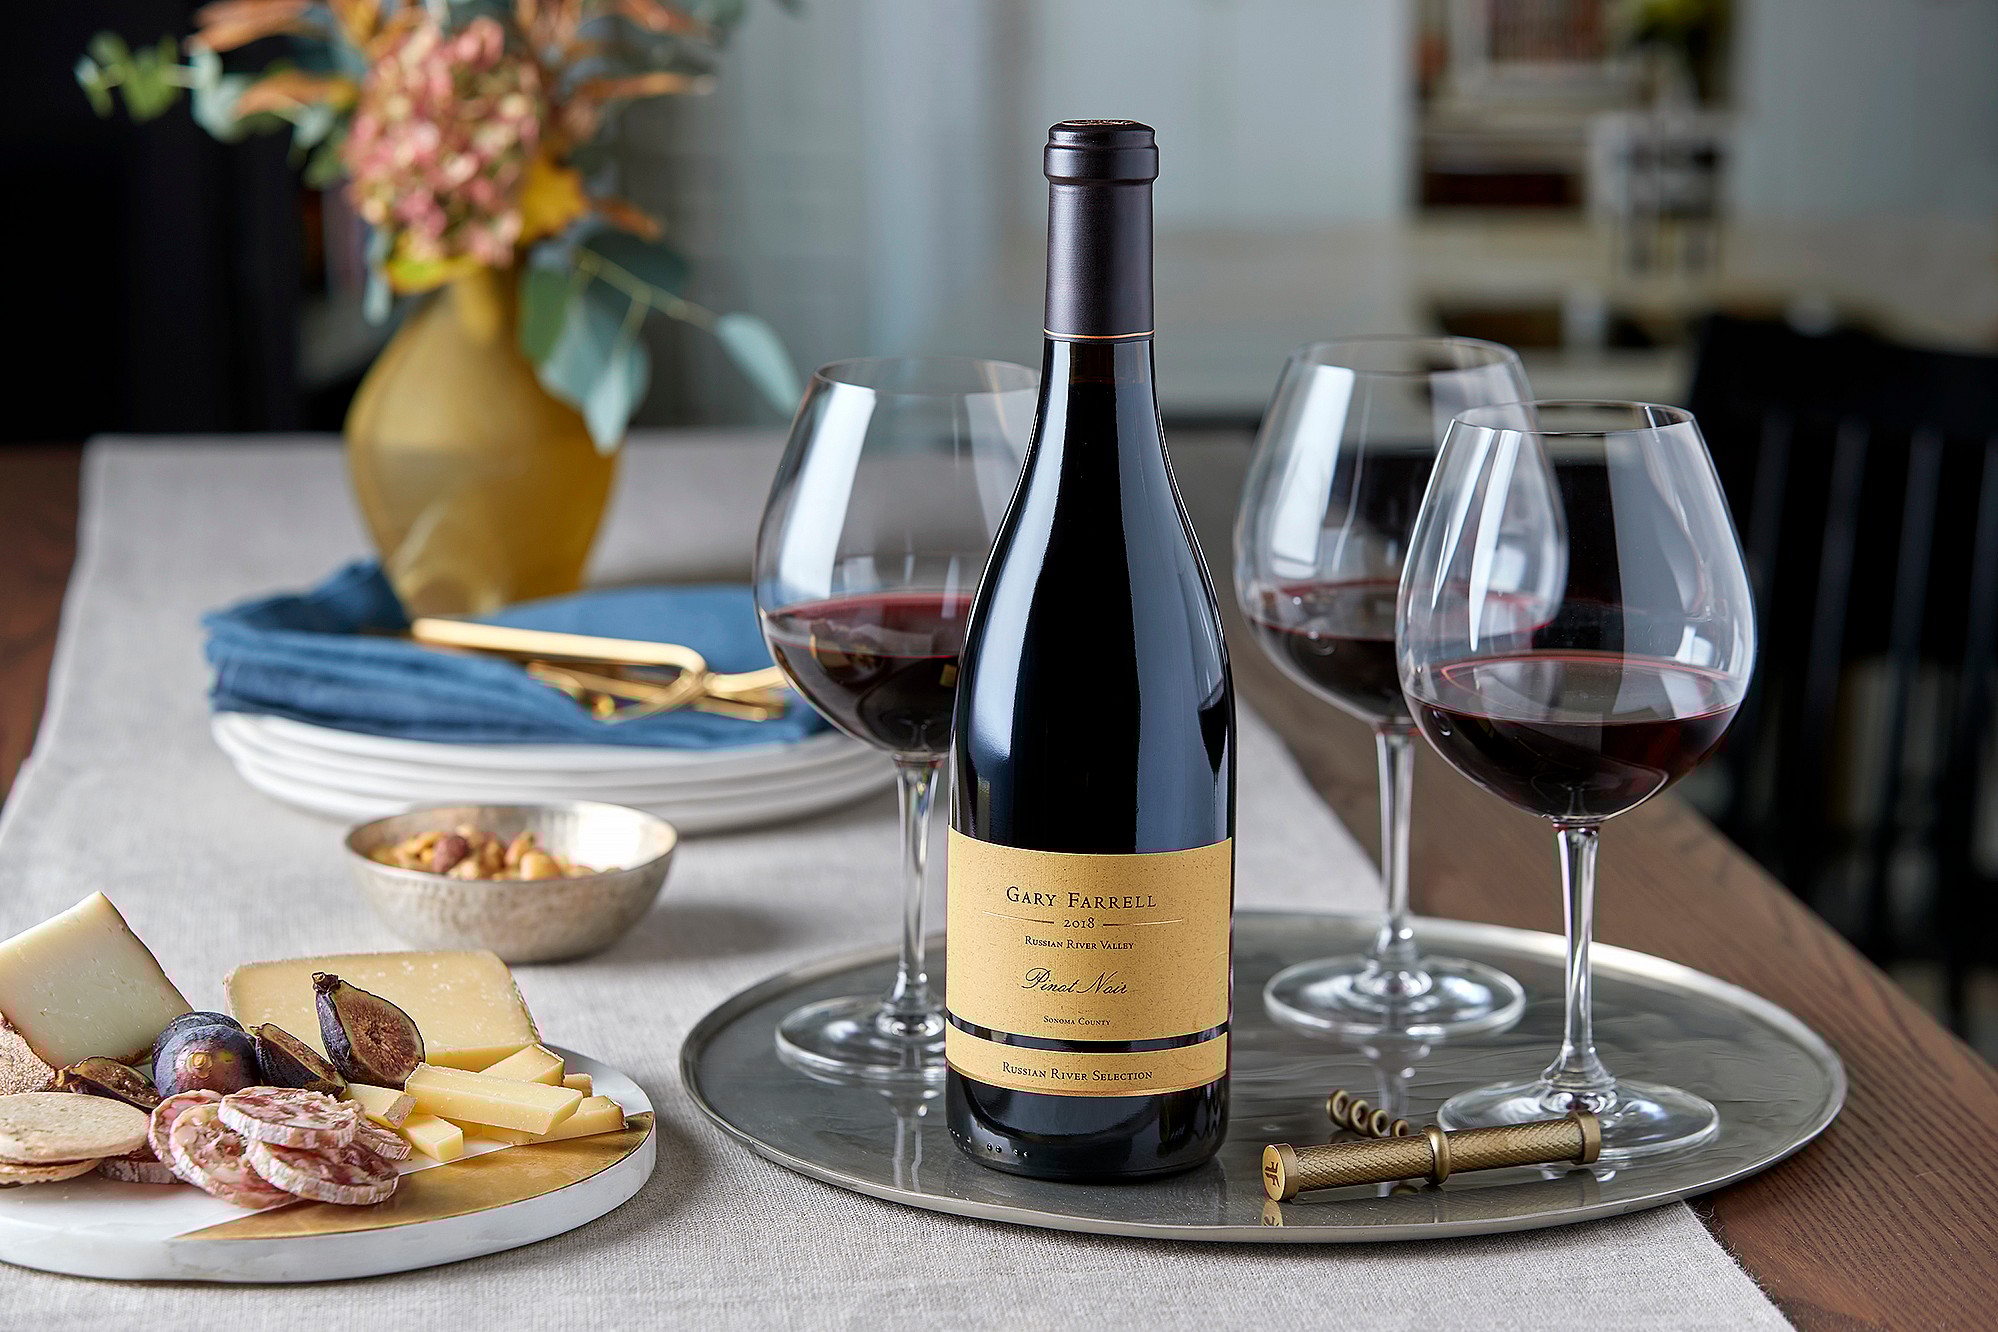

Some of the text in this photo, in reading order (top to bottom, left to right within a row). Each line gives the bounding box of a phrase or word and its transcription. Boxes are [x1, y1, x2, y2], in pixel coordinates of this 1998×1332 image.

[1006, 886, 1157, 910] GARY FARRELL
[1063, 917, 1095, 929] 2018
[1025, 936, 1134, 950] RUSSIAN RIVER VALLEY
[1021, 967, 1128, 995] Pinot Noir
[1043, 1015, 1111, 1026] SONOMA COUNTY
[1002, 1061, 1153, 1081] RUSSIAN RIVER SELECTION
